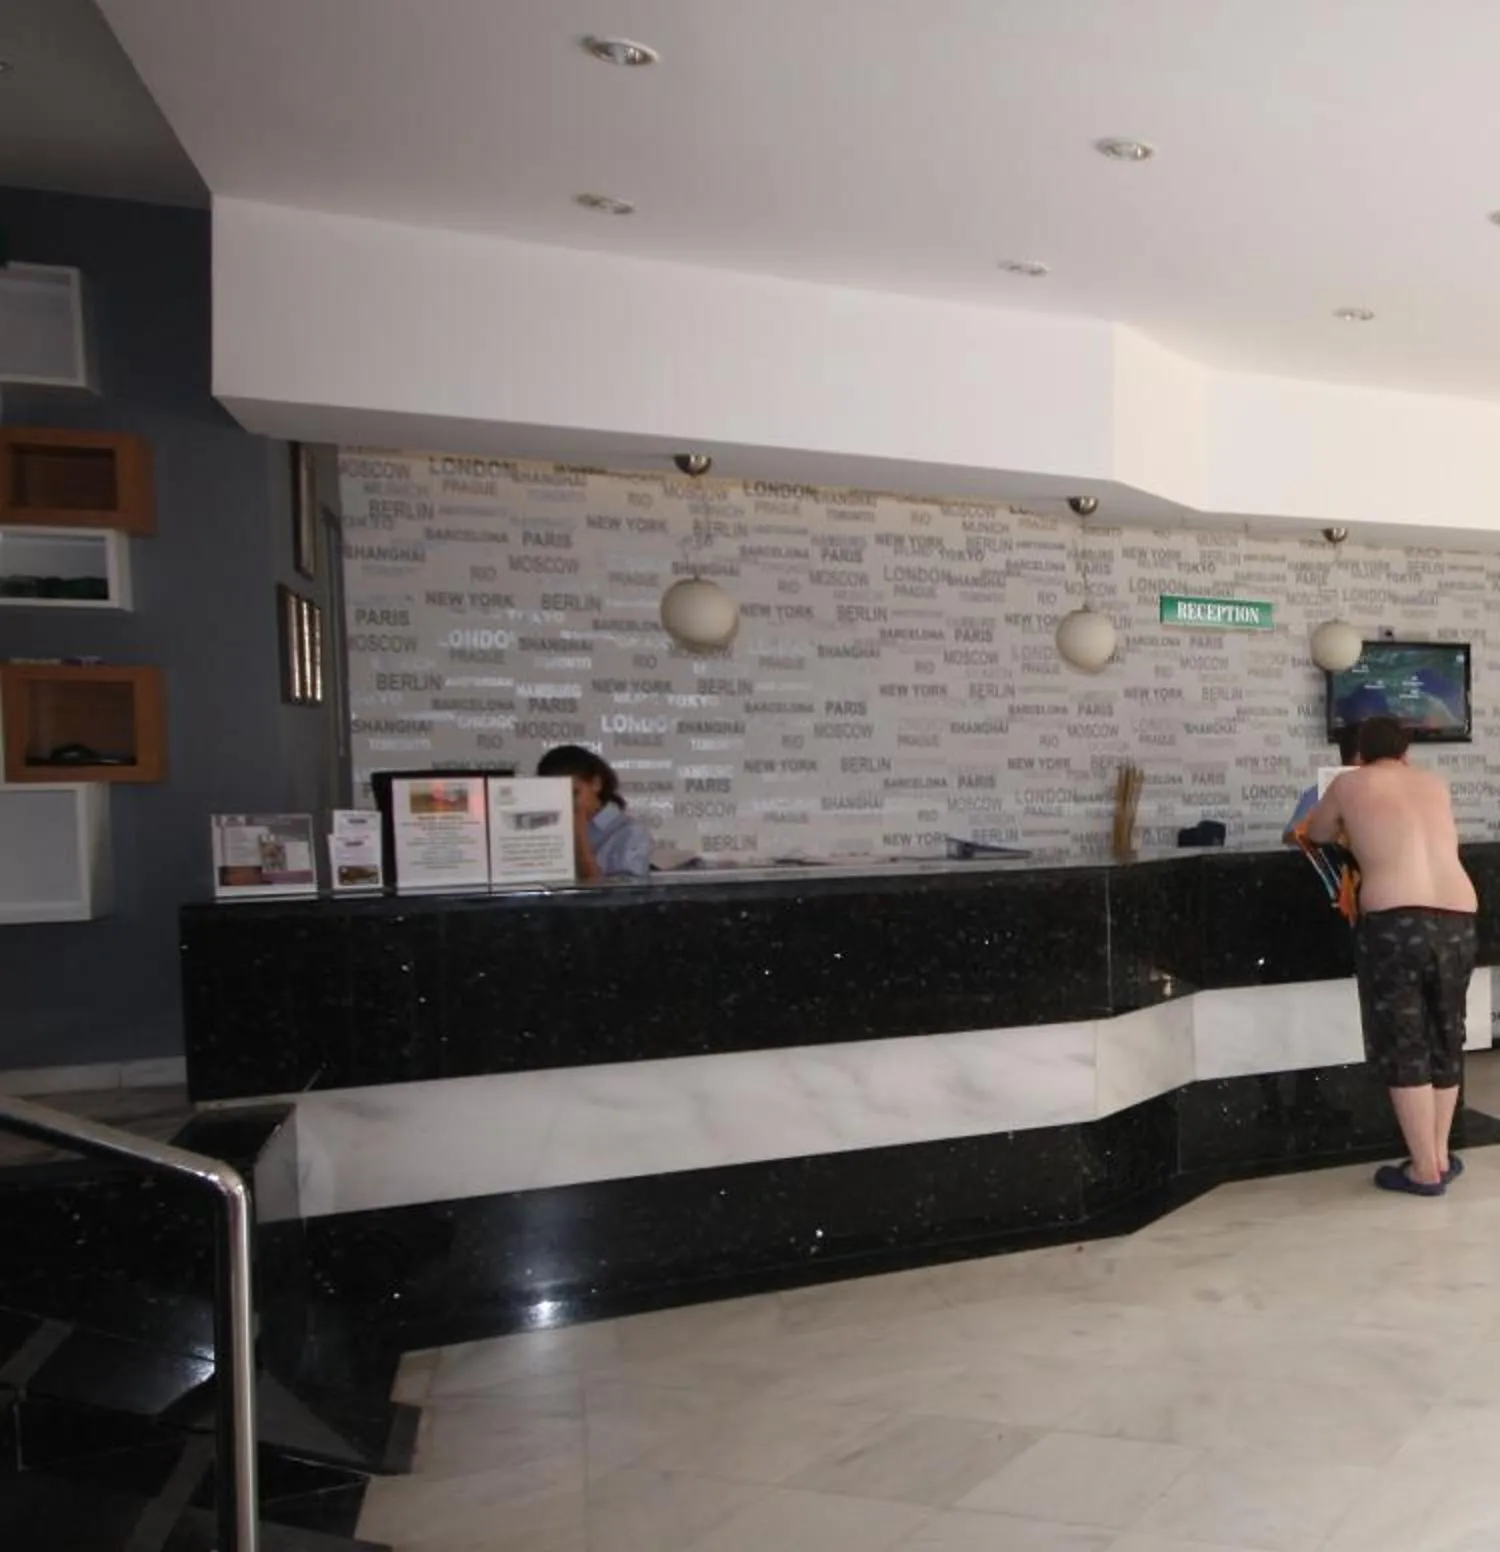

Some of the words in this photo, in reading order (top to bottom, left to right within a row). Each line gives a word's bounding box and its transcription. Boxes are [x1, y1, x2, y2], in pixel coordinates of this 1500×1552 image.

[368, 499, 435, 521] BERLIN
[586, 514, 622, 529] NEW
[626, 516, 668, 532] YORK
[522, 531, 572, 549] PARIS
[875, 533, 905, 546] NEW
[908, 535, 943, 549] YORK
[966, 536, 1013, 551] BERLIN
[821, 547, 863, 563] PARIS
[508, 554, 580, 574] MOSCOW
[470, 566, 497, 582] RIO
[808, 570, 870, 587] MOSCOW
[883, 566, 948, 582] LONDON
[777, 579, 802, 594] RIO
[1129, 577, 1187, 593] LONDON
[425, 591, 464, 607] NEW
[468, 592, 515, 608] YORK
[541, 593, 602, 612] BERLIN
[355, 609, 410, 626] PARIS
[739, 603, 771, 618] NEW
[775, 605, 815, 619] YORK
[836, 604, 889, 622] BERLIN
[1176, 602, 1260, 624] RECEPTION
[1004, 613, 1032, 625] NEW
[1037, 614, 1058, 626] YO
[954, 628, 993, 643] PARIS
[1189, 636, 1223, 648] PARIS
[817, 644, 880, 658] SHANGHAI
[632, 654, 657, 669] RIO
[1181, 654, 1228, 670] MOSCOW
[376, 673, 443, 691] BERLIN
[593, 679, 626, 693] NEW
[631, 679, 673, 693] YORK
[697, 678, 753, 695] BERLIN
[879, 684, 910, 697] NEW
[914, 684, 948, 697] YORK
[969, 683, 1016, 699] BERLIN
[1123, 687, 1150, 699] NEW
[1153, 688, 1183, 701] YORK
[1202, 687, 1243, 701] BERLIN
[528, 698, 578, 713] PARIS
[824, 700, 867, 716] PARIS
[1077, 702, 1114, 717] PARIS
[351, 719, 434, 734] SHANGHAI
[515, 721, 585, 738] MOSCOW
[676, 720, 746, 734] SHANGHAI
[813, 721, 874, 739] MOSCOW
[950, 721, 1008, 734] SHANGHAI
[1067, 723, 1118, 738] MOSCOW
[476, 734, 504, 750] RIO
[781, 734, 804, 749] RIO
[1039, 735, 1059, 749] RIO
[743, 759, 776, 773] NEW
[782, 759, 818, 773] YORK
[840, 756, 894, 774] BERLIN
[1007, 757, 1034, 770] NEW
[1038, 757, 1071, 770] YORK
[685, 778, 732, 793] PARIS
[957, 774, 996, 789] PARIS
[1242, 784, 1298, 799] LONDON
